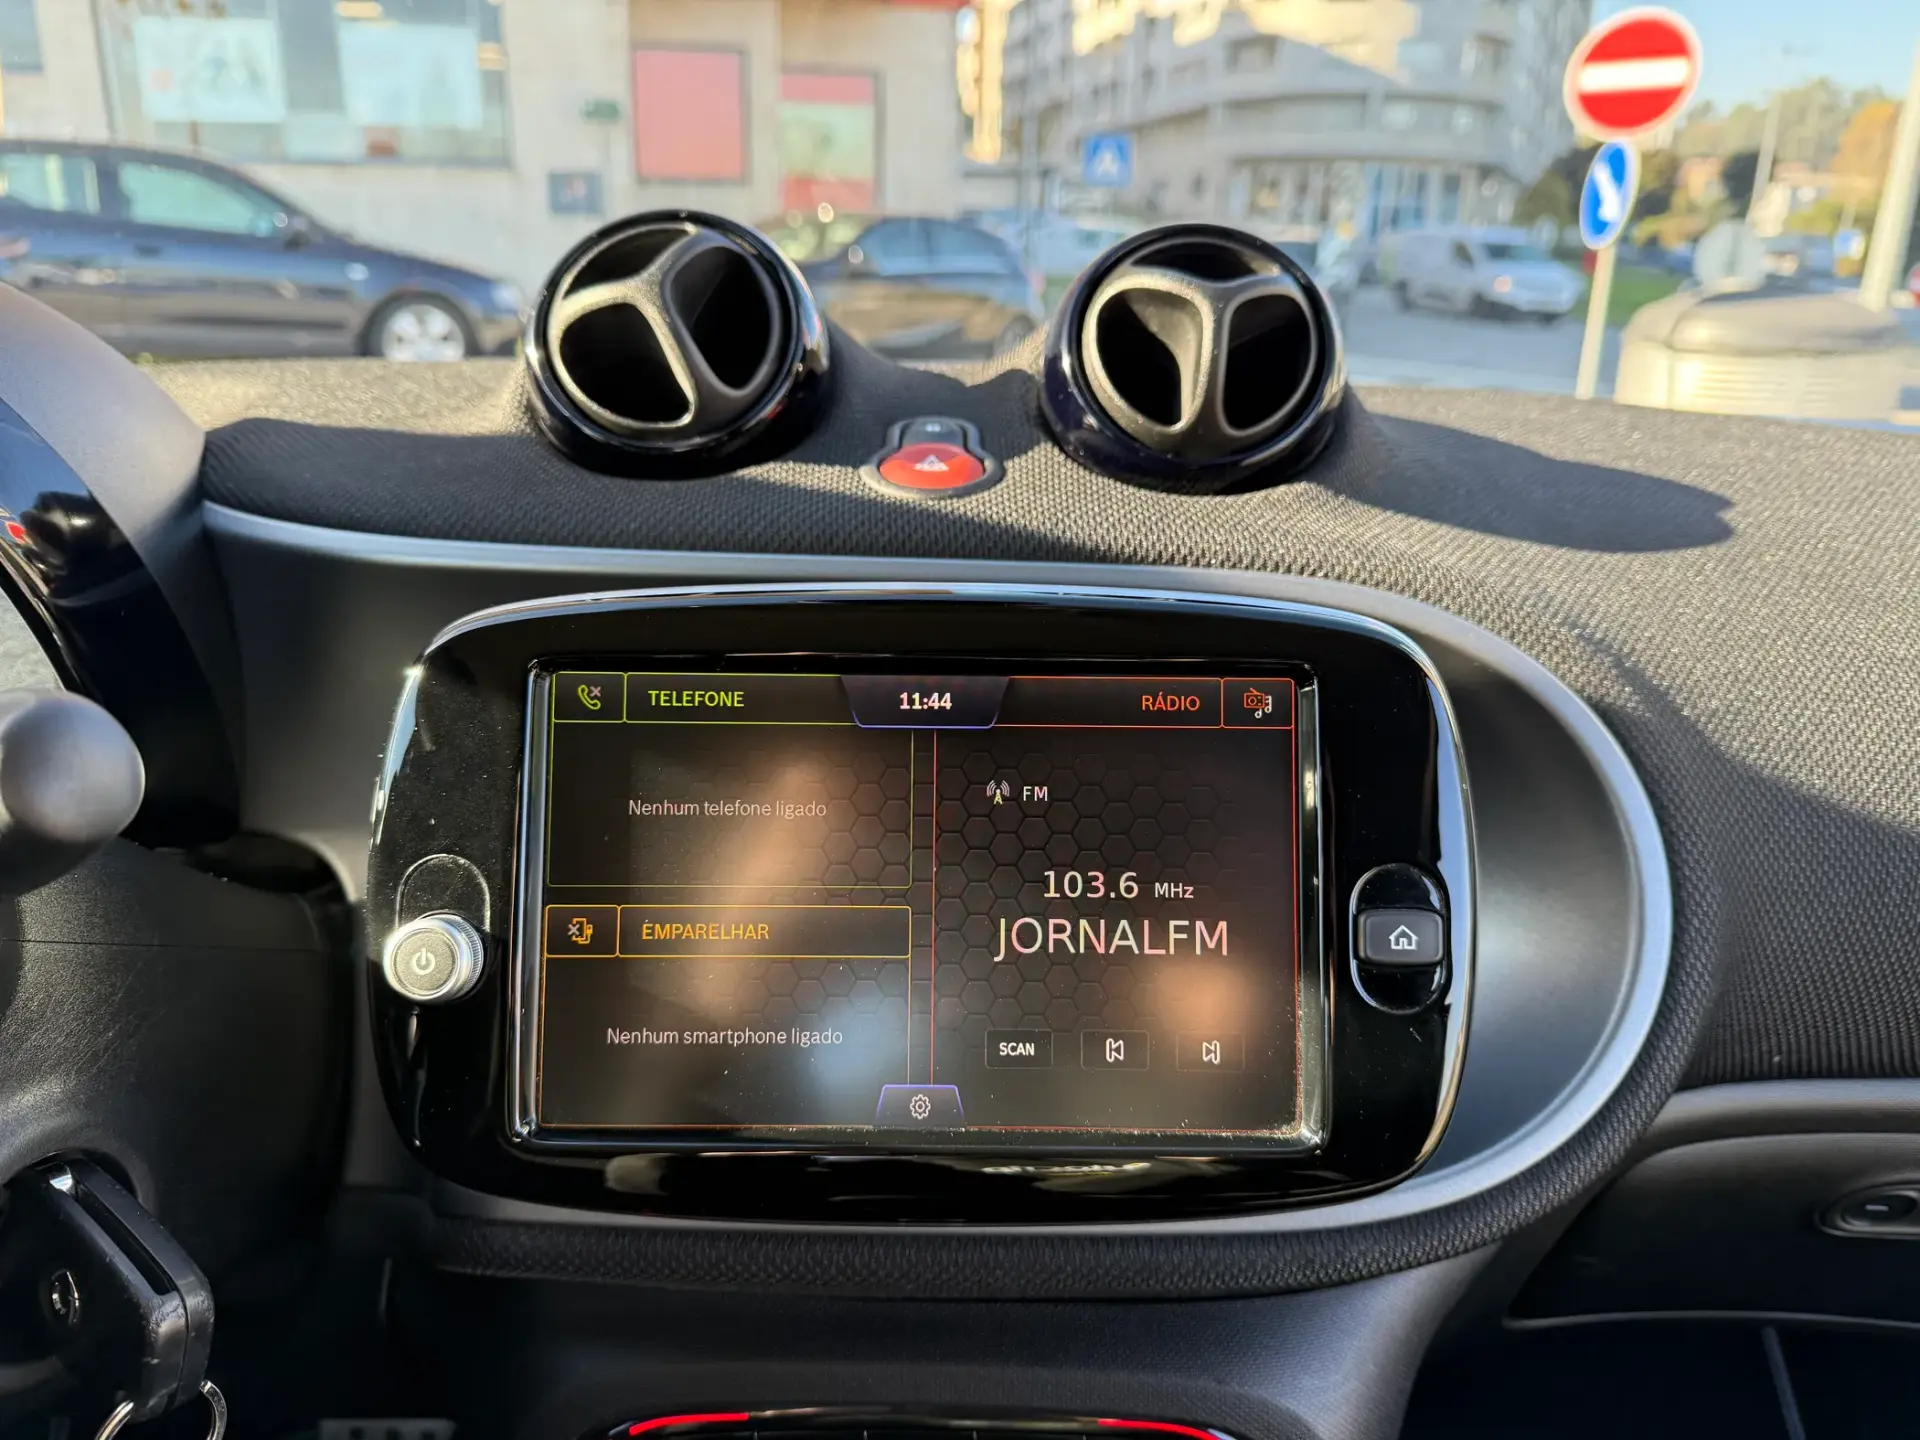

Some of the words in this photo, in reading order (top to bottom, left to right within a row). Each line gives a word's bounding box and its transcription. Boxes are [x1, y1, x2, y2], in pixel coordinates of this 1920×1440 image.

[648, 689, 745, 708] TELEFONE
[899, 692, 952, 710] 11:44
[1141, 691, 1201, 712] RÁDIO
[1022, 785, 1049, 802] FM
[628, 799, 700, 816] Nenhum
[703, 799, 772, 816] telefone
[776, 800, 827, 820] ligado
[1043, 870, 1139, 899] 103.6
[1154, 882, 1194, 899] MHz
[993, 917, 1228, 962] JORNALFM
[606, 1027, 679, 1044] Nenhum
[683, 1028, 787, 1048] smartphone
[791, 1027, 843, 1048] ligado
[999, 1041, 1035, 1057] SCAN
